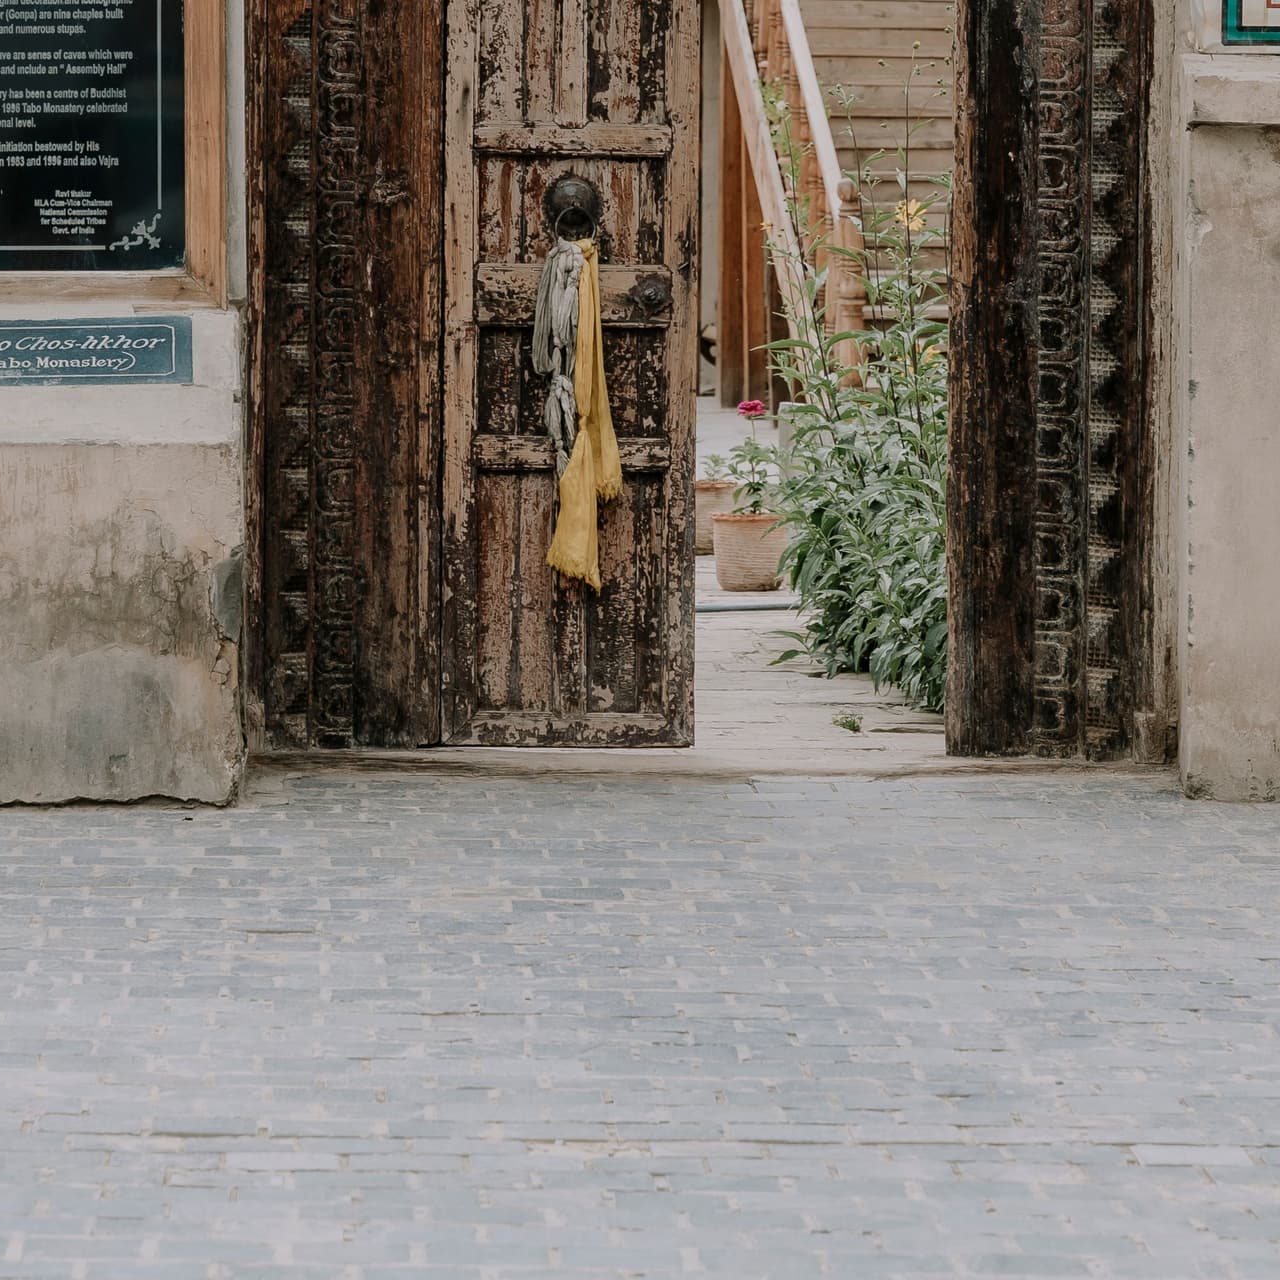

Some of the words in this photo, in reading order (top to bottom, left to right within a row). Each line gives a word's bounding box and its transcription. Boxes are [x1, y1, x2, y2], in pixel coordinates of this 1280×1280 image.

[5, 9, 37, 21] (Gonpa)
[53, 9, 71, 19] nine
[104, 8, 123, 18] built
[56, 24, 86, 35] stupas.
[87, 49, 112, 59] which
[113, 51, 133, 59] were
[16, 64, 46, 74] include
[65, 64, 105, 76] Assembly
[25, 89, 45, 98] been
[53, 90, 78, 98] centre
[90, 88, 126, 98] Buddhist
[22, 103, 41, 113] Tabo
[43, 103, 84, 115] Monastery
[86, 103, 127, 112] celebrated
[14, 117, 36, 127] level.
[34, 141, 72, 151] bestowed
[79, 156, 97, 165] also
[16, 335, 165, 353] Chos-hkhor
